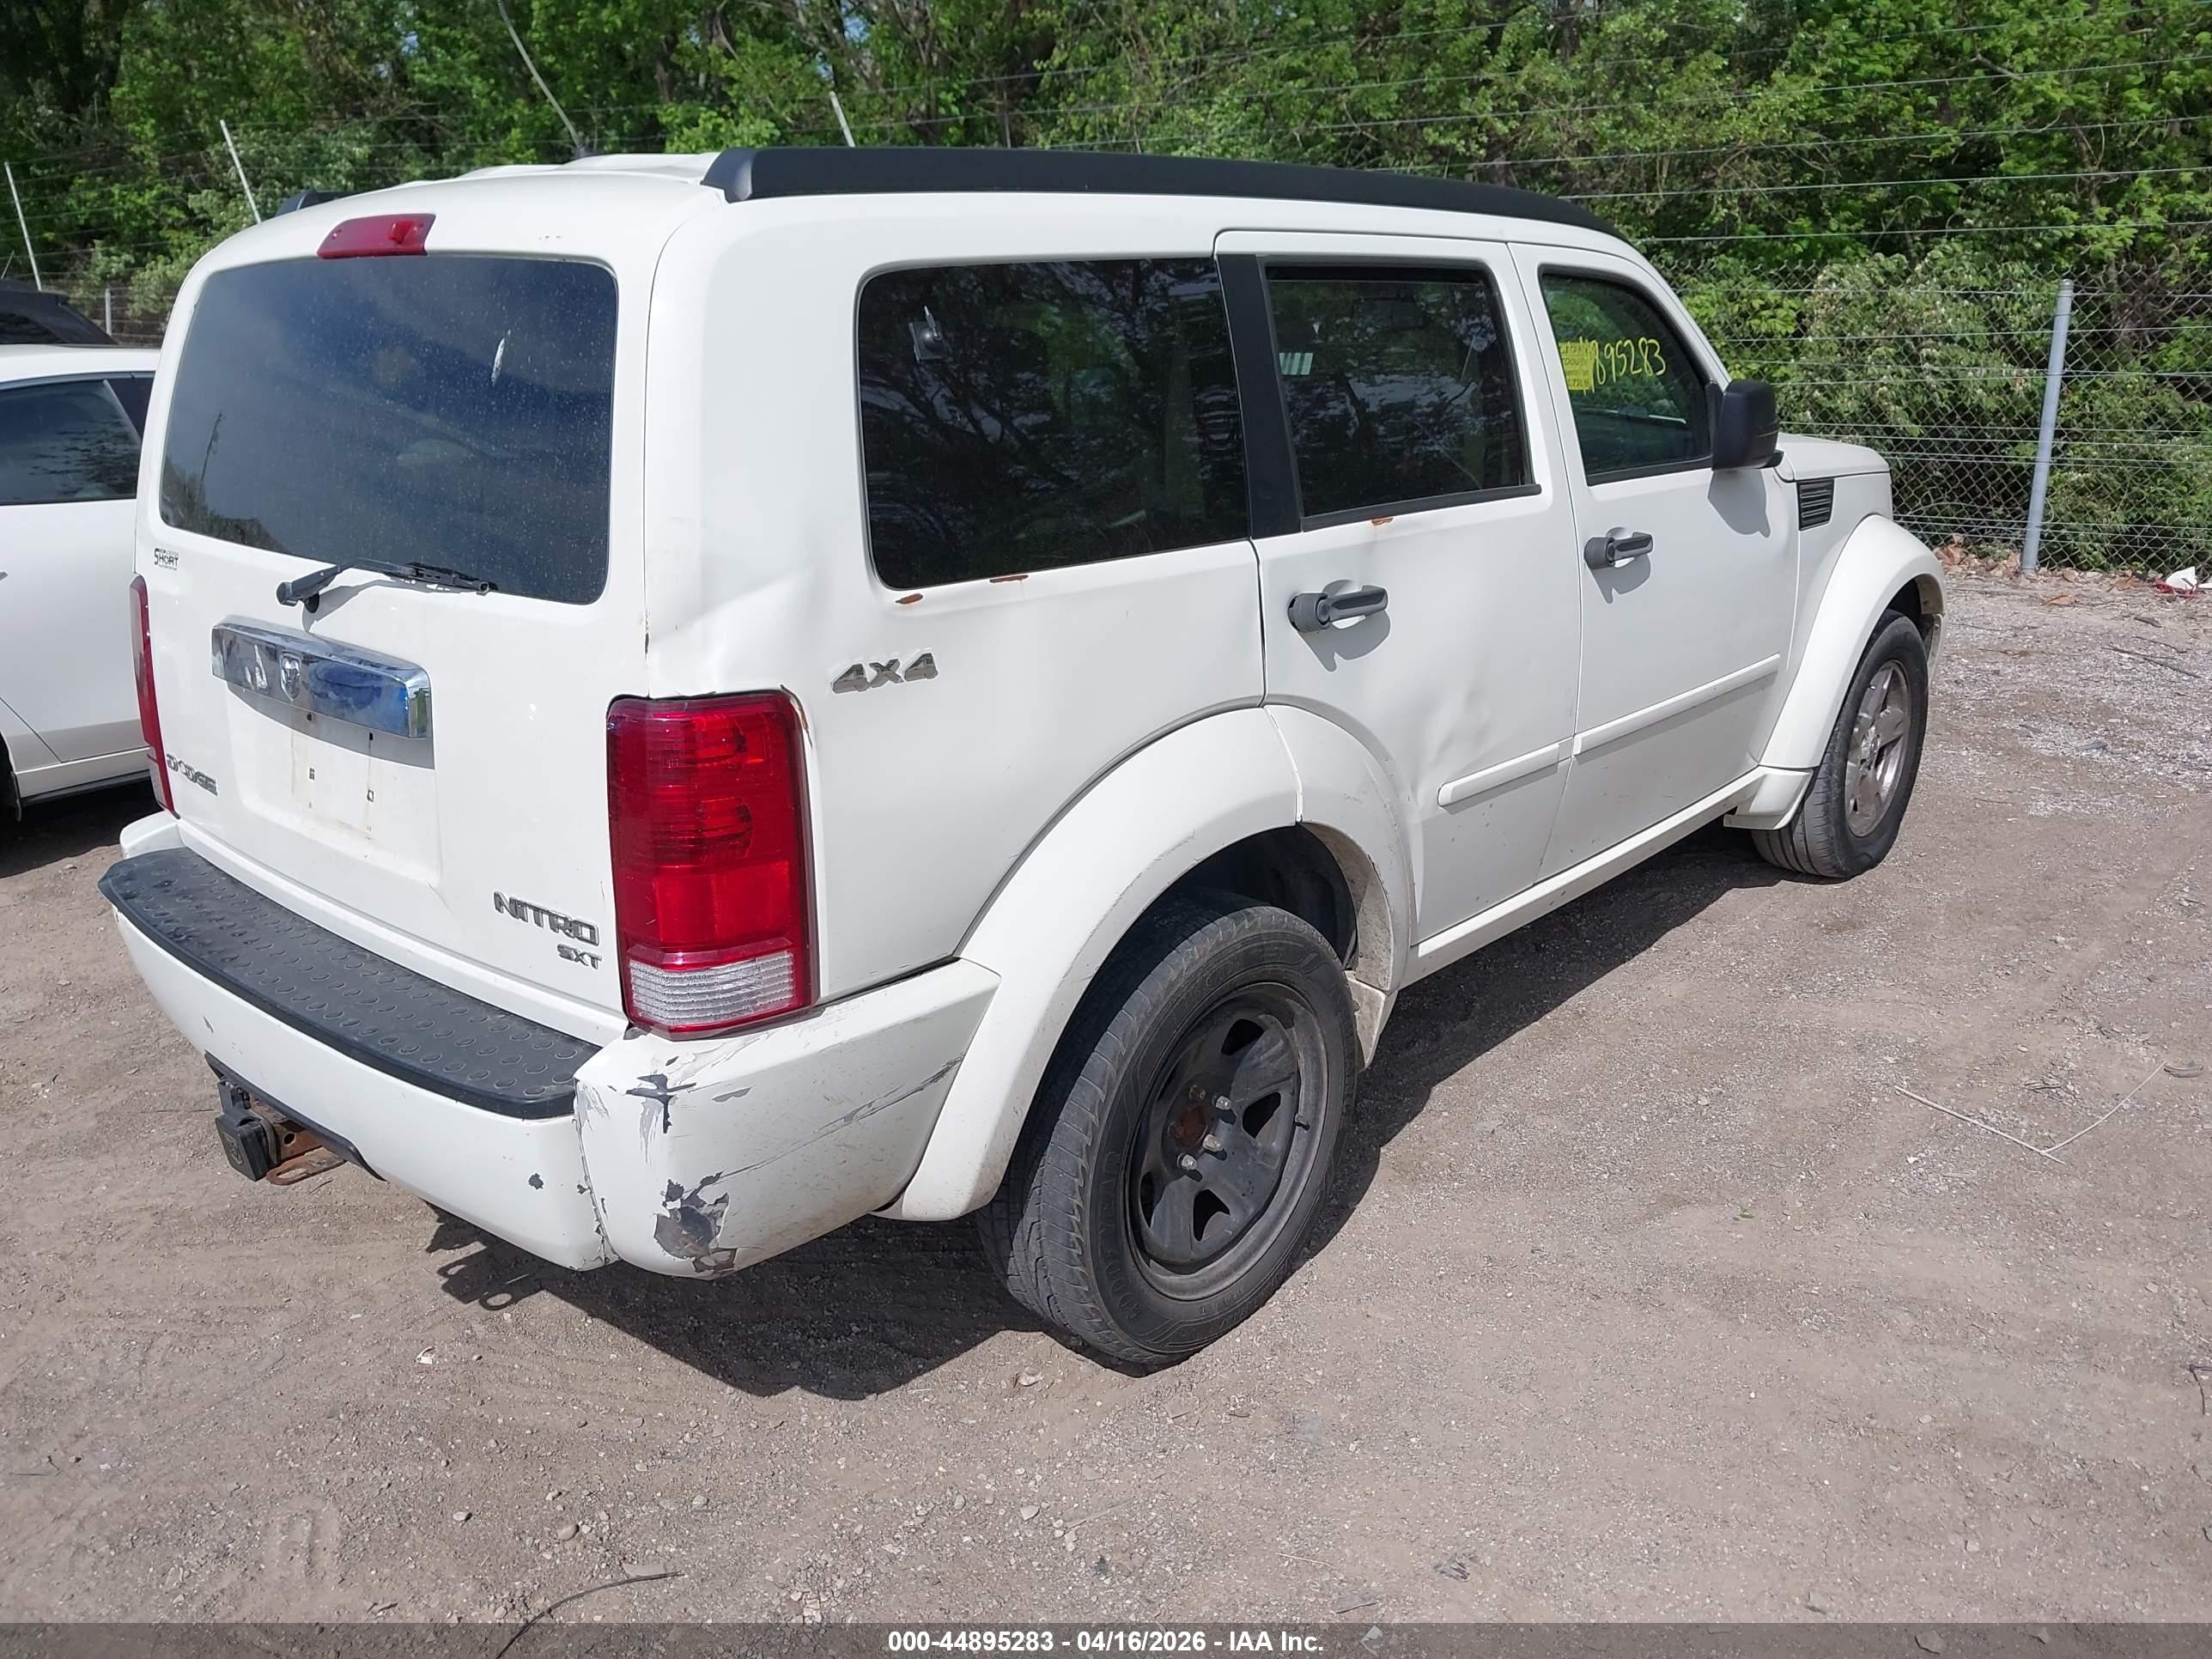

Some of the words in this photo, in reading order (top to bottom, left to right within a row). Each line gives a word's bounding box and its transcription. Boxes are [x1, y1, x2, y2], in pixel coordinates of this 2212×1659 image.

[167, 753, 218, 797] DODGE
[494, 891, 599, 946] NITRO
[557, 944, 602, 969] SXT
